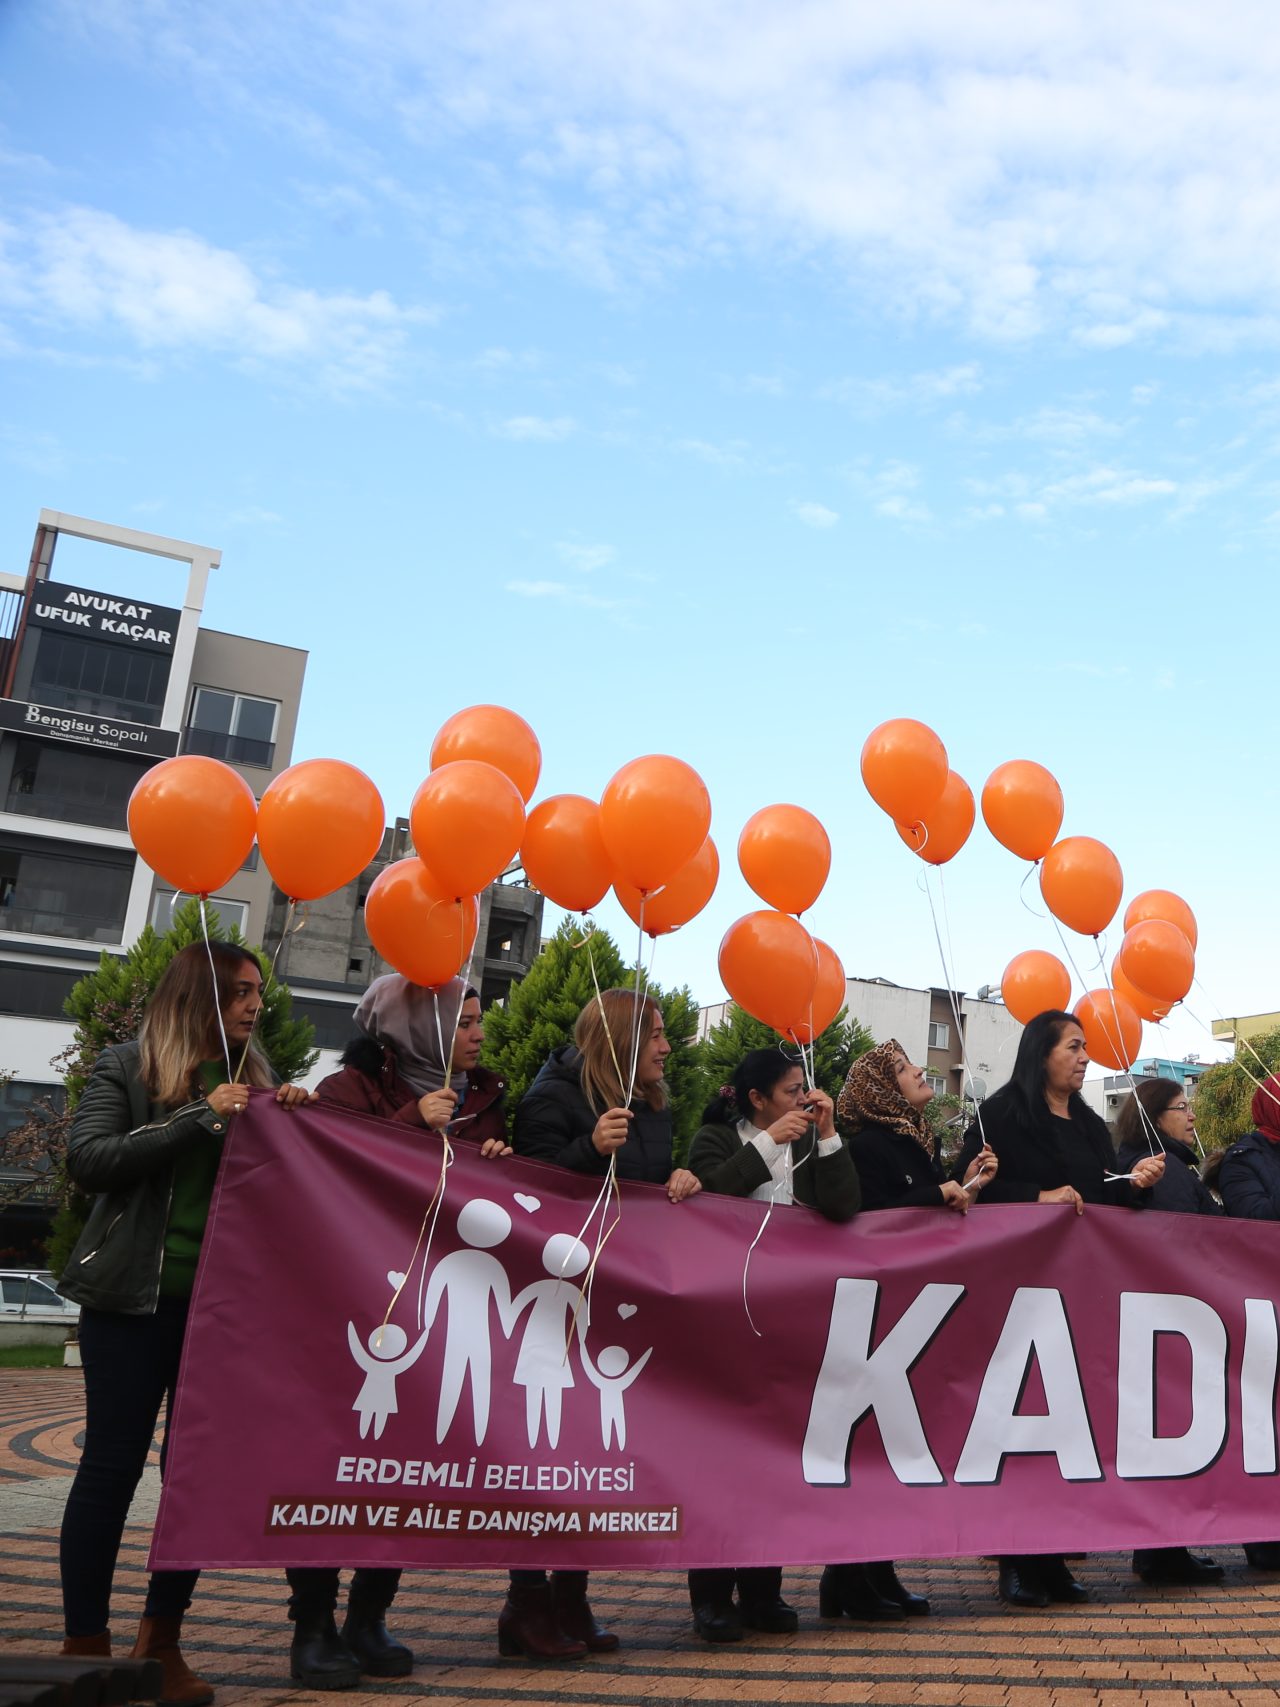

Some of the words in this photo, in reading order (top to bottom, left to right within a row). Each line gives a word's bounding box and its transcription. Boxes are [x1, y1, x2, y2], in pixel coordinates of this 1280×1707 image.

[35, 603, 93, 628] UFUK
[101, 618, 172, 645] KAÇAR
[65, 592, 152, 620] AVUKAT
[25, 705, 94, 733] Bengisu
[98, 724, 148, 743] Sopalı
[336, 1456, 477, 1488] ERDEMLİ
[484, 1460, 635, 1492] BELEDİYESİ
[271, 1503, 357, 1527] KADIN
[365, 1506, 400, 1528] VE
[404, 1503, 462, 1531] AİLE
[467, 1510, 581, 1537] DANIŞMA
[588, 1506, 678, 1533] MERKEZİ
